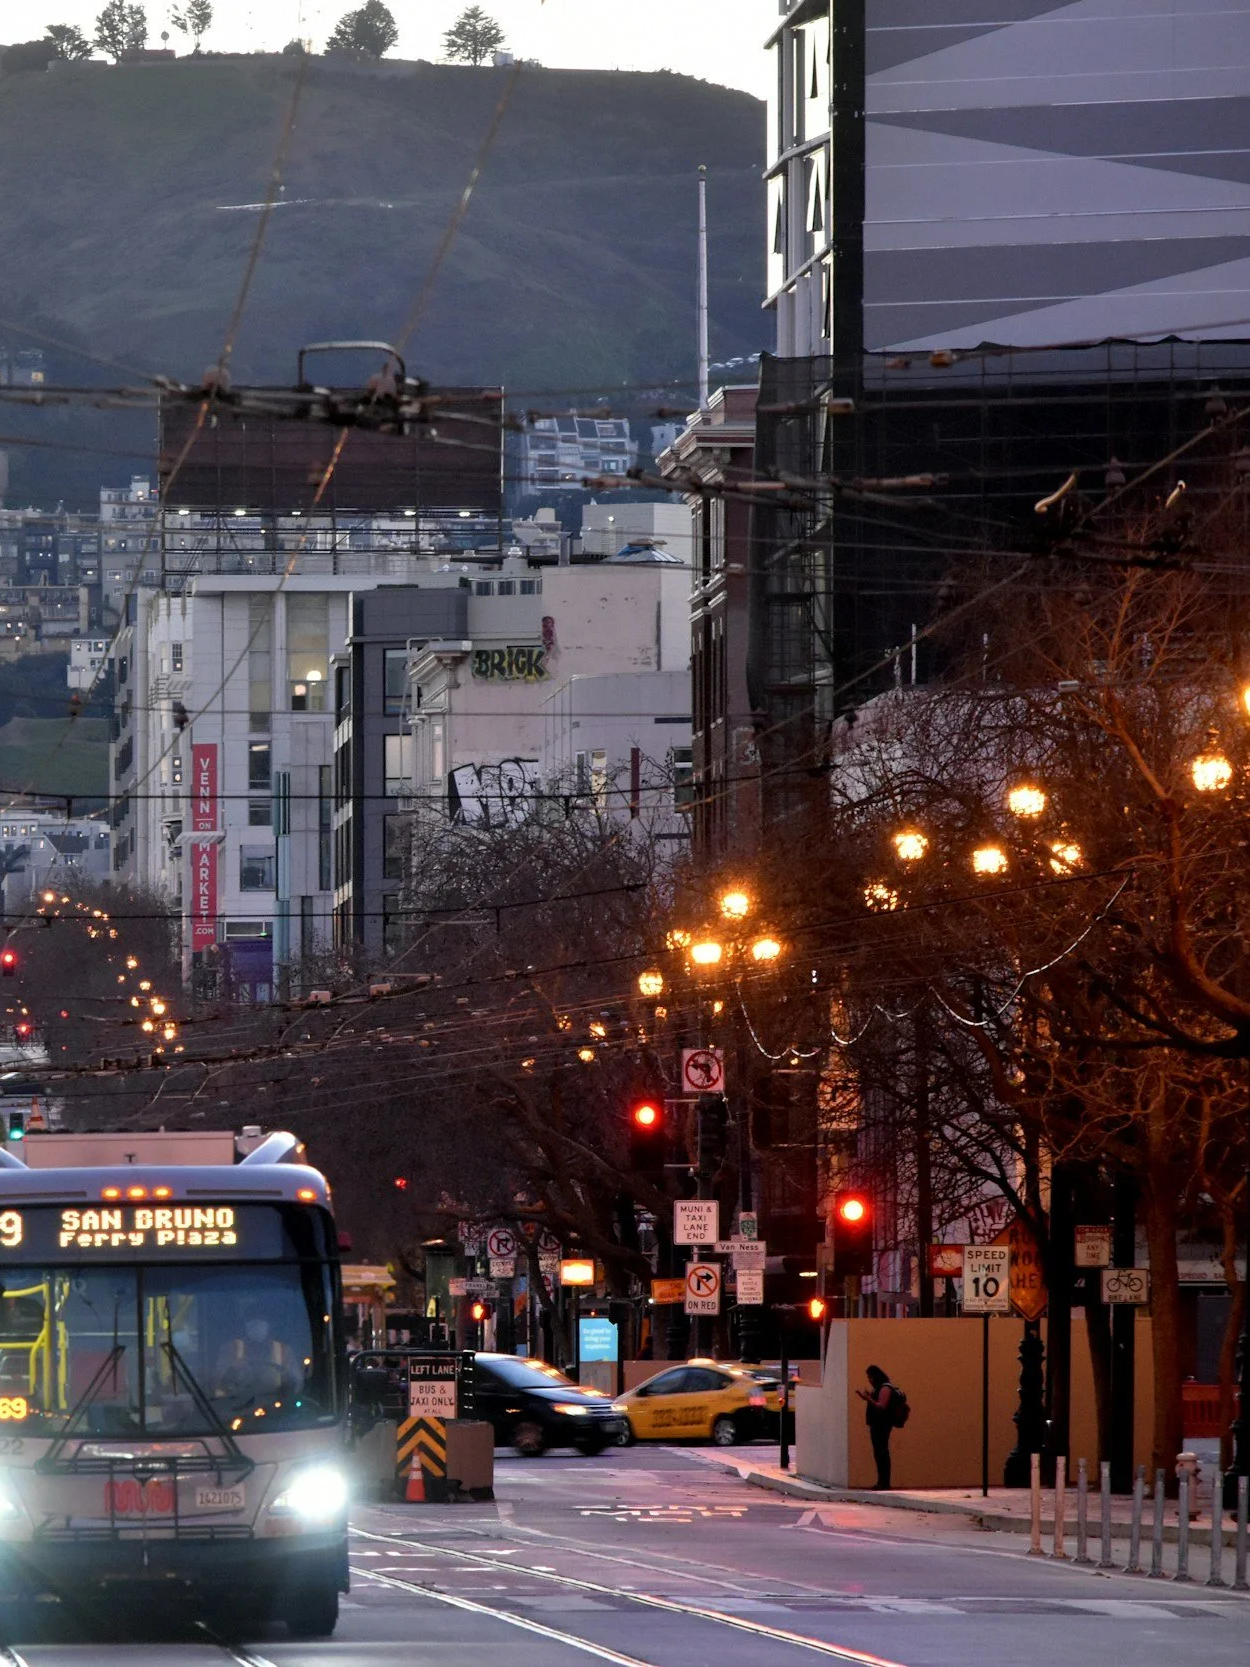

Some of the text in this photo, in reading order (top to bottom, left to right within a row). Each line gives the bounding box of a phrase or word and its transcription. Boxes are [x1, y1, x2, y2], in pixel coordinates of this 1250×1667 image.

[473, 649, 549, 680] BRICK
[199, 757, 210, 814] VENN
[198, 822, 212, 830] ON
[199, 842, 210, 924] MARKET
[61, 1208, 235, 1231] SAN BRUNO
[683, 1223, 709, 1231] LANE
[59, 1230, 238, 1248] Ferry Plaza
[686, 1232, 706, 1240] END
[720, 1243, 759, 1251] Van Ness
[967, 1250, 1006, 1260] SPEED
[1086, 1252, 1100, 1260] TIME
[971, 1263, 1002, 1273] LIMIT
[972, 1277, 1000, 1298] 10
[1108, 1294, 1142, 1302] BIKE LANE
[687, 1300, 717, 1310] ON RED
[410, 1364, 455, 1375] LEFT LANE
[419, 1384, 447, 1394] BUS &
[410, 1396, 454, 1406] TAXI ONLY
